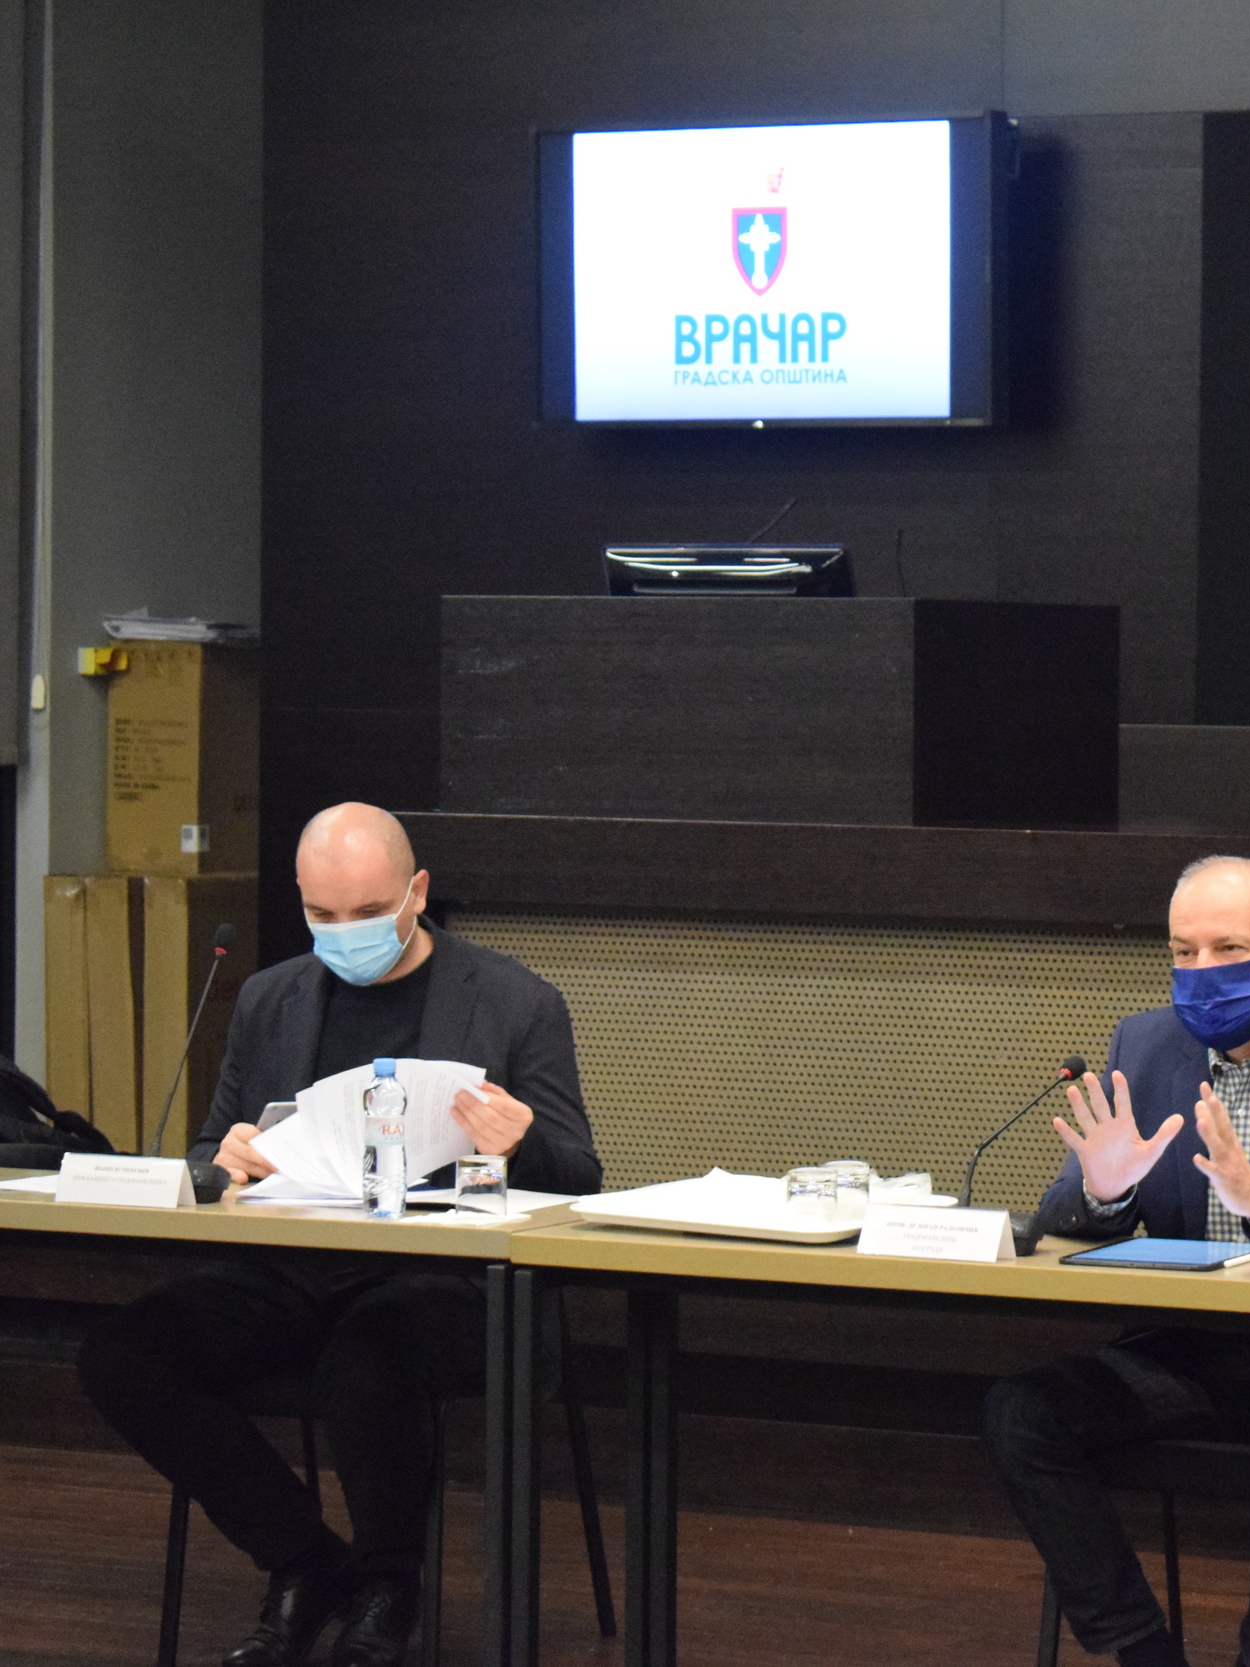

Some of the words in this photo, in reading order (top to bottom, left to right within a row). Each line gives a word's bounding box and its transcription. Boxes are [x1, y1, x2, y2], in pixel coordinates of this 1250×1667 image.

[674, 311, 847, 365] ВРАЧАР
[674, 369, 754, 387] ГРАДСКА
[760, 368, 848, 384] ОПШТИНА
